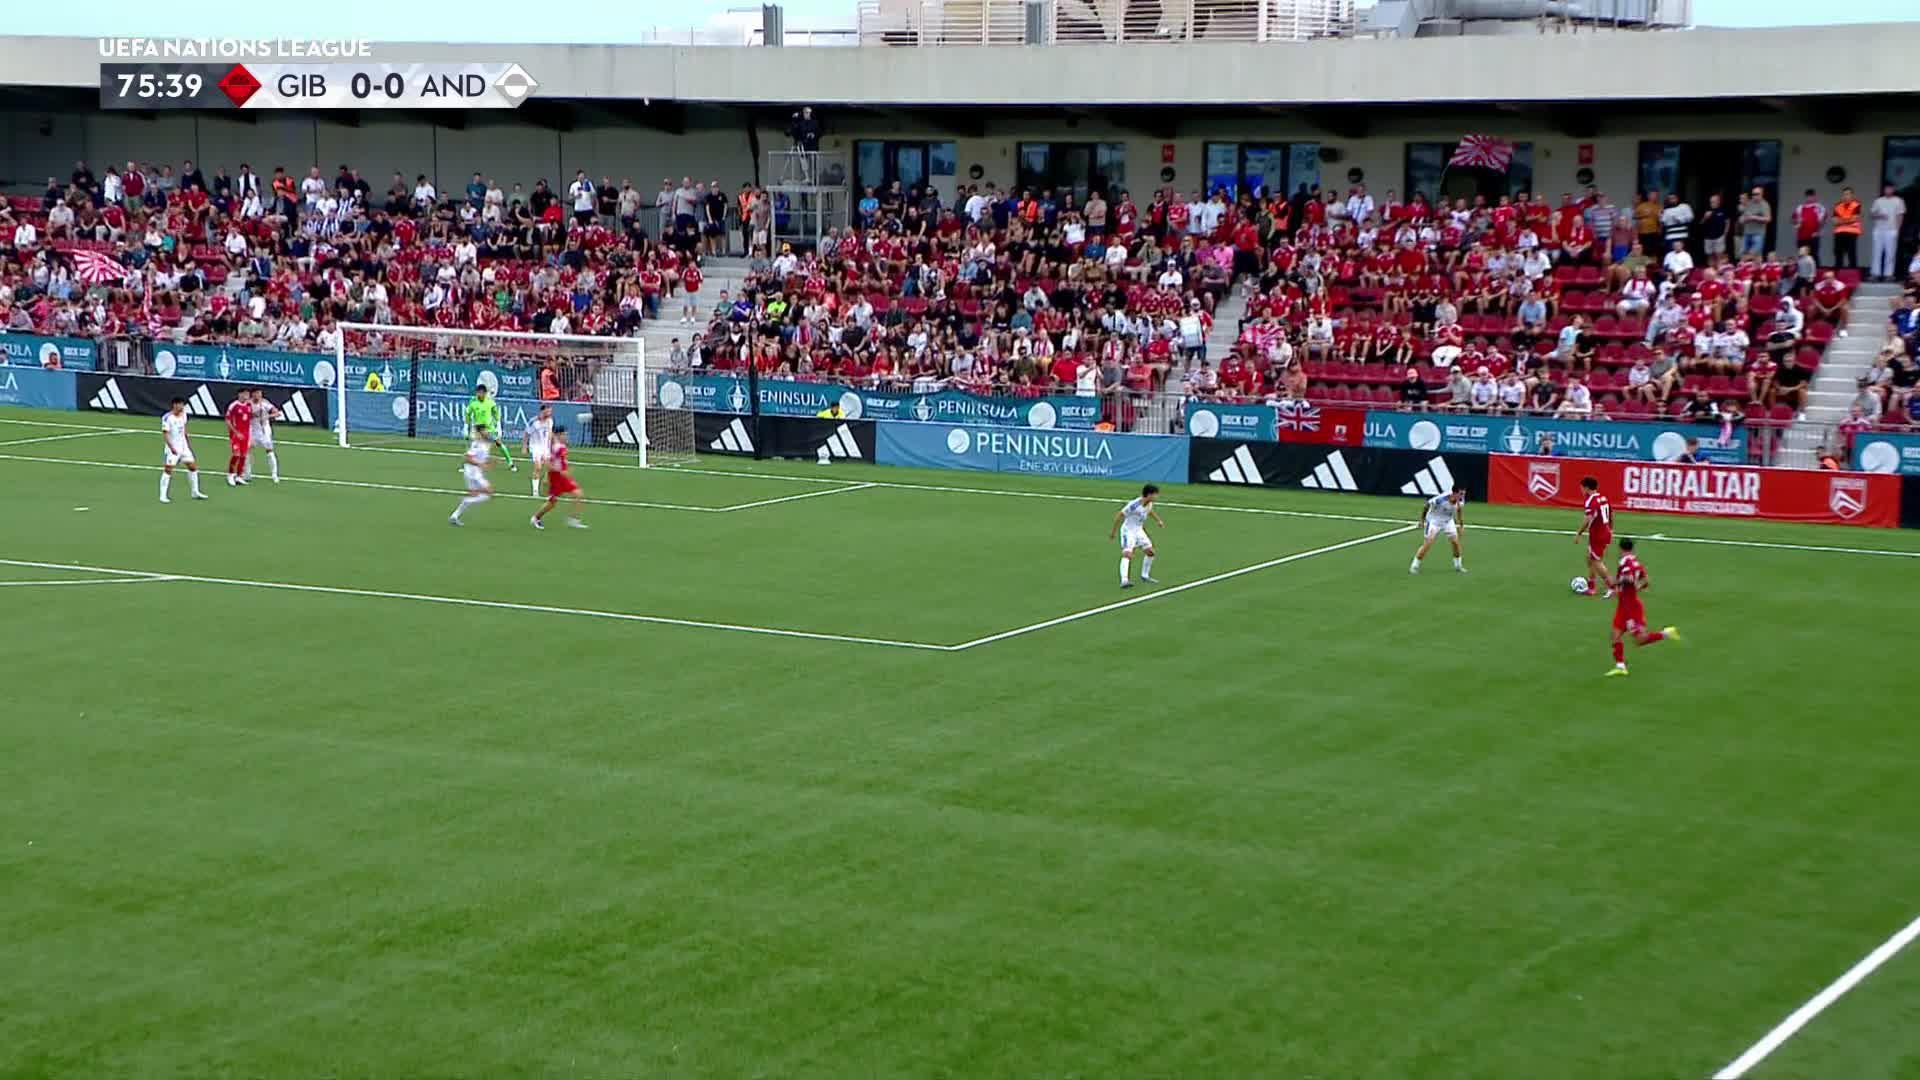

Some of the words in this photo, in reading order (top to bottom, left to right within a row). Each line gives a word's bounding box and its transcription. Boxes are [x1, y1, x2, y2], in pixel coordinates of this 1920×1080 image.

[236, 359, 304, 375] PENINSULA
[757, 390, 827, 406] ENINSULA
[939, 400, 1017, 419] PENINSULA
[976, 433, 1113, 460] PENINSULA
[1624, 466, 1760, 501] GIBRALTAR
